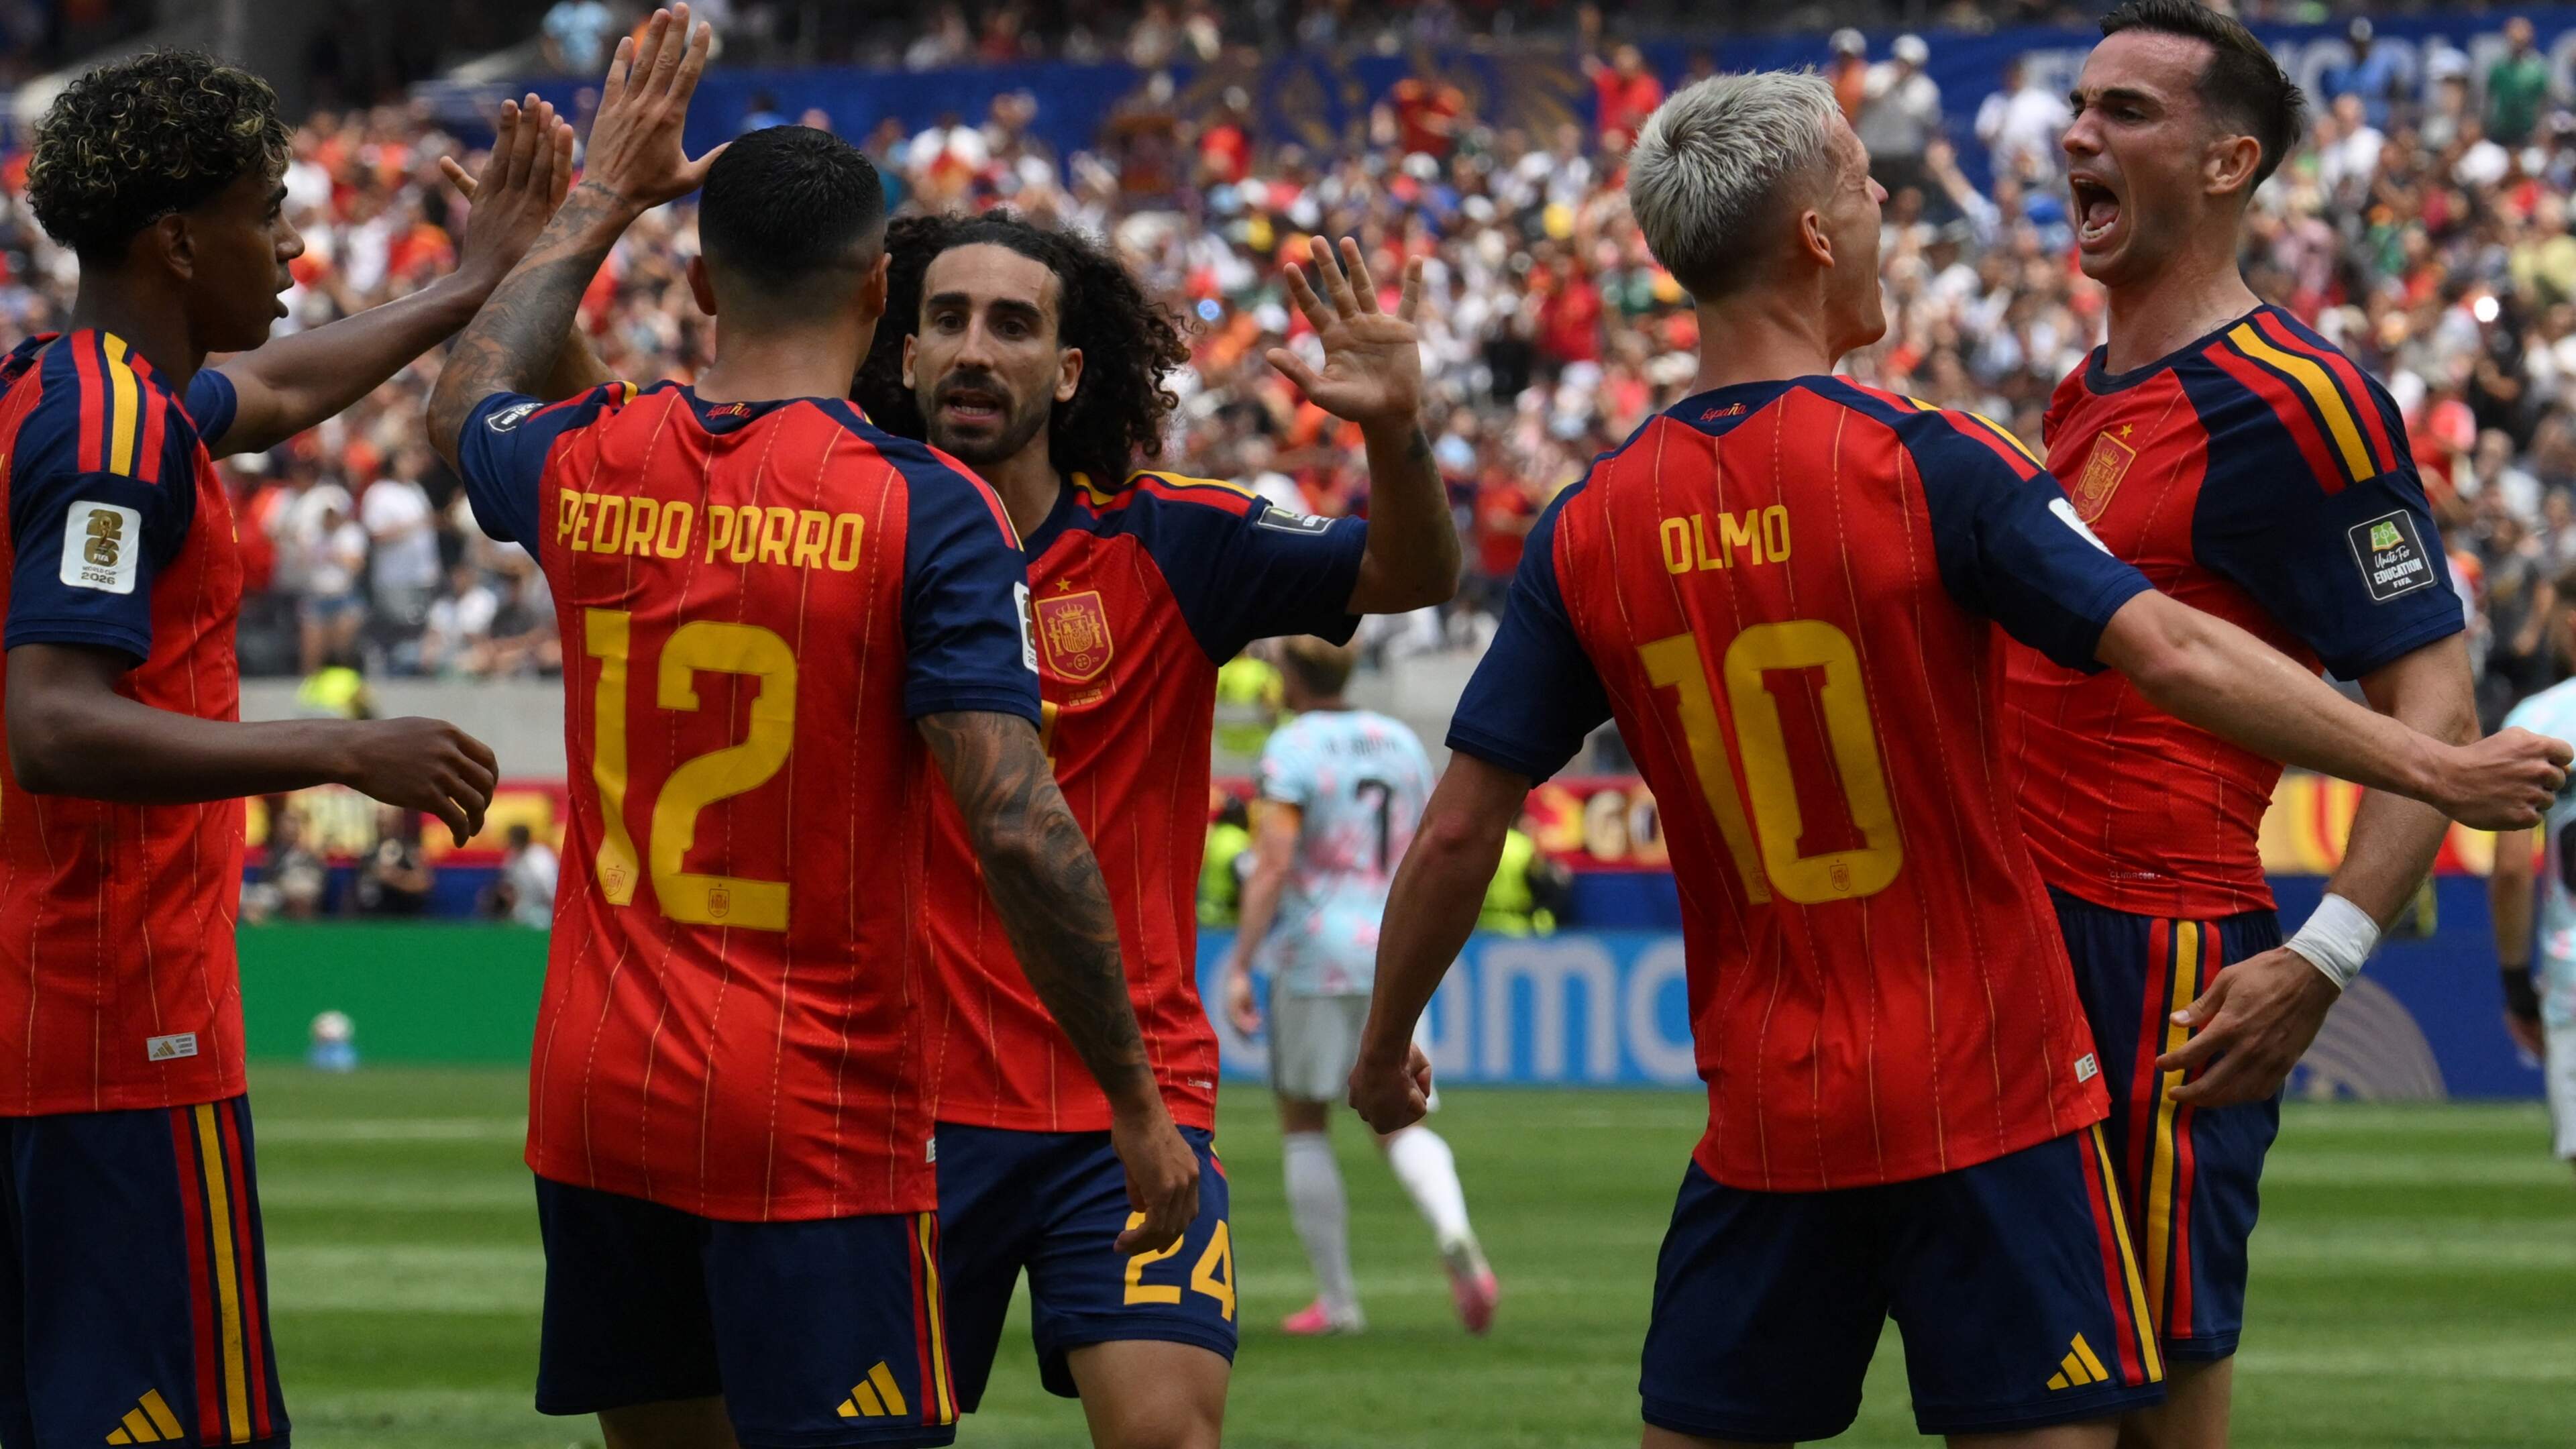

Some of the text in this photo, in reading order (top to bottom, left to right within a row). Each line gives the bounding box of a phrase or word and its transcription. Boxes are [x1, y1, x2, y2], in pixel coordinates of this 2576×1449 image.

[1700, 402, 1747, 422] España
[556, 487, 865, 572] PEDRO PORRO
[1659, 504, 1791, 575] OLMO
[80, 572, 116, 585] 2026
[2373, 557, 2423, 585] EDUCATION
[2392, 577, 2413, 588] FIFA
[584, 606, 798, 933] 12
[1638, 619, 1904, 906] 10
[1356, 779, 1394, 871] 7
[1123, 1210, 1235, 1324] 24
